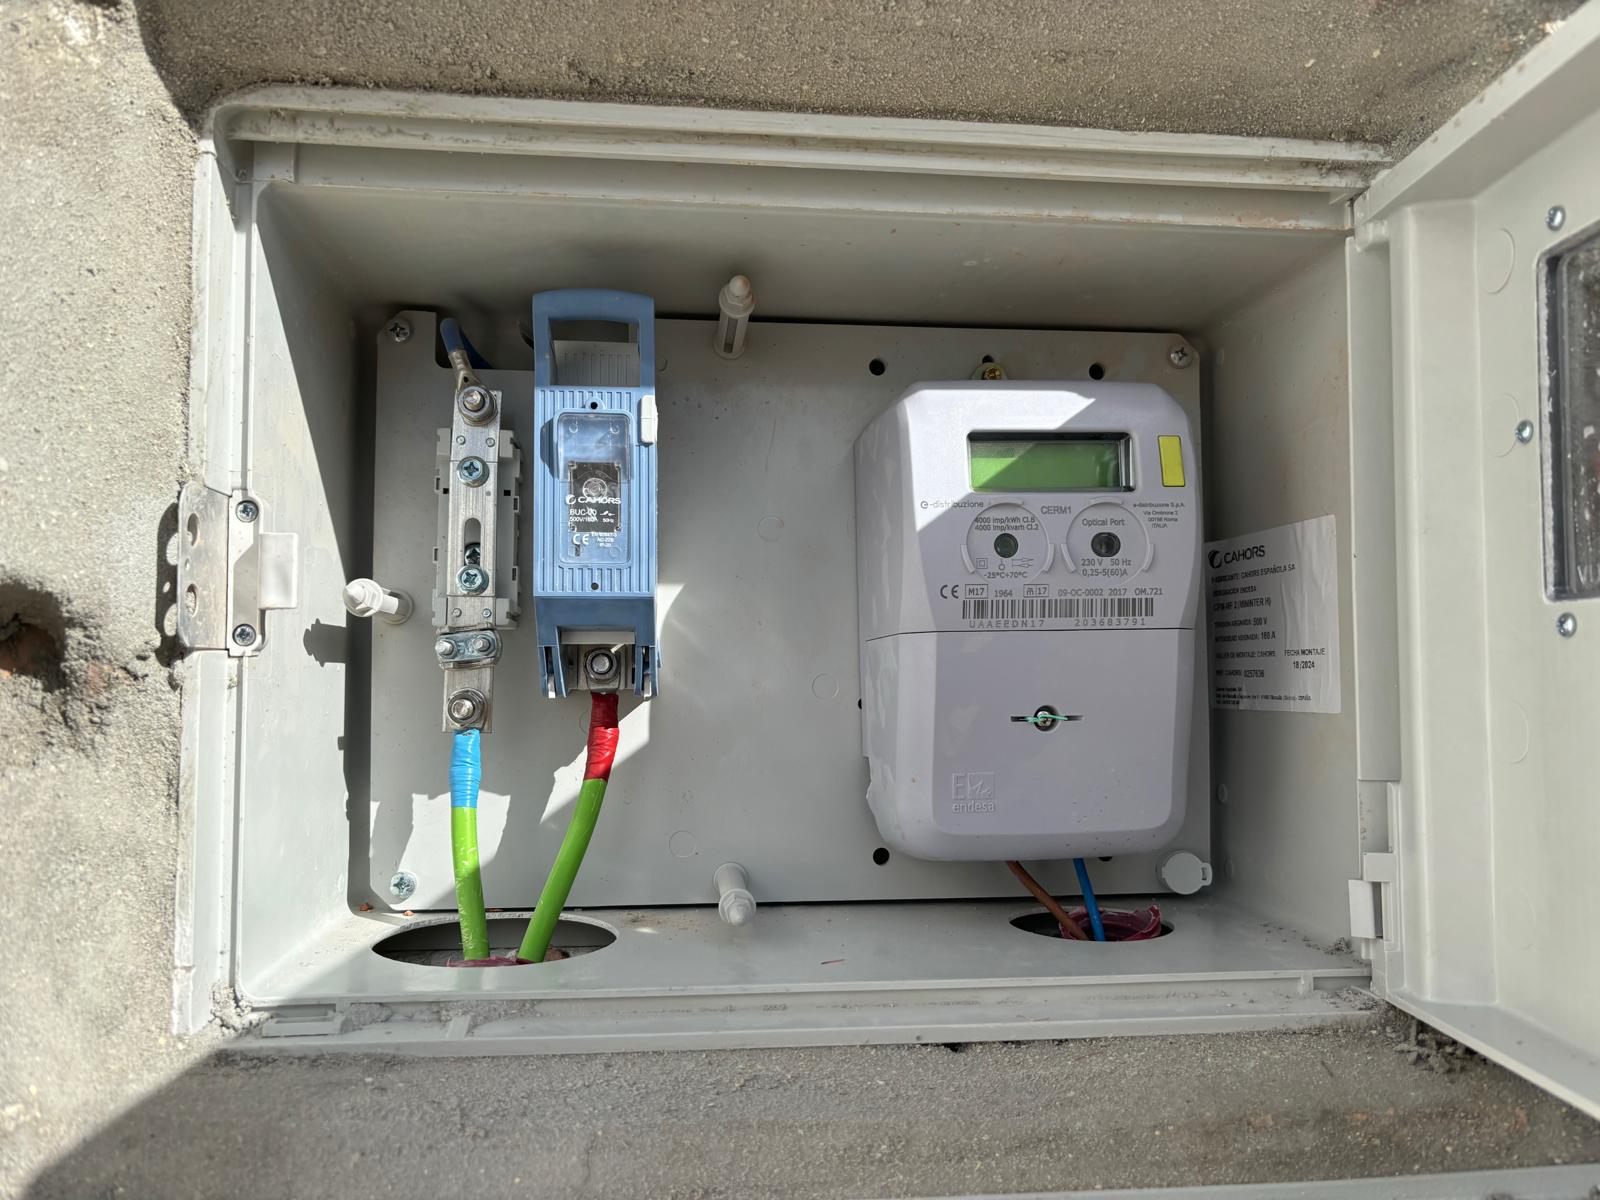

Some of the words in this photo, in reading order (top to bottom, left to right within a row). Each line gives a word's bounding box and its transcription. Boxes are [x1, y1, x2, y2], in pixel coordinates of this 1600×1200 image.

[578, 496, 622, 505] CAHORS
[1040, 505, 1073, 515] CERM1
[1081, 518, 1108, 527] Optical
[1110, 518, 1126, 526] Port
[1223, 545, 1266, 565] CAHORS
[1080, 558, 1096, 567] 230
[1097, 558, 1103, 567] V
[1109, 558, 1120, 566] 50
[1121, 558, 1132, 566] Hz
[968, 587, 985, 596] M17
[994, 589, 1013, 598] 1964
[1108, 587, 1128, 596] 2017
[1134, 587, 1163, 596] OM.721
[1284, 649, 1300, 657] FECHA
[1300, 648, 1326, 657] MONTAJE
[1293, 660, 1316, 670] 18/2024
[951, 799, 995, 813] endesa
